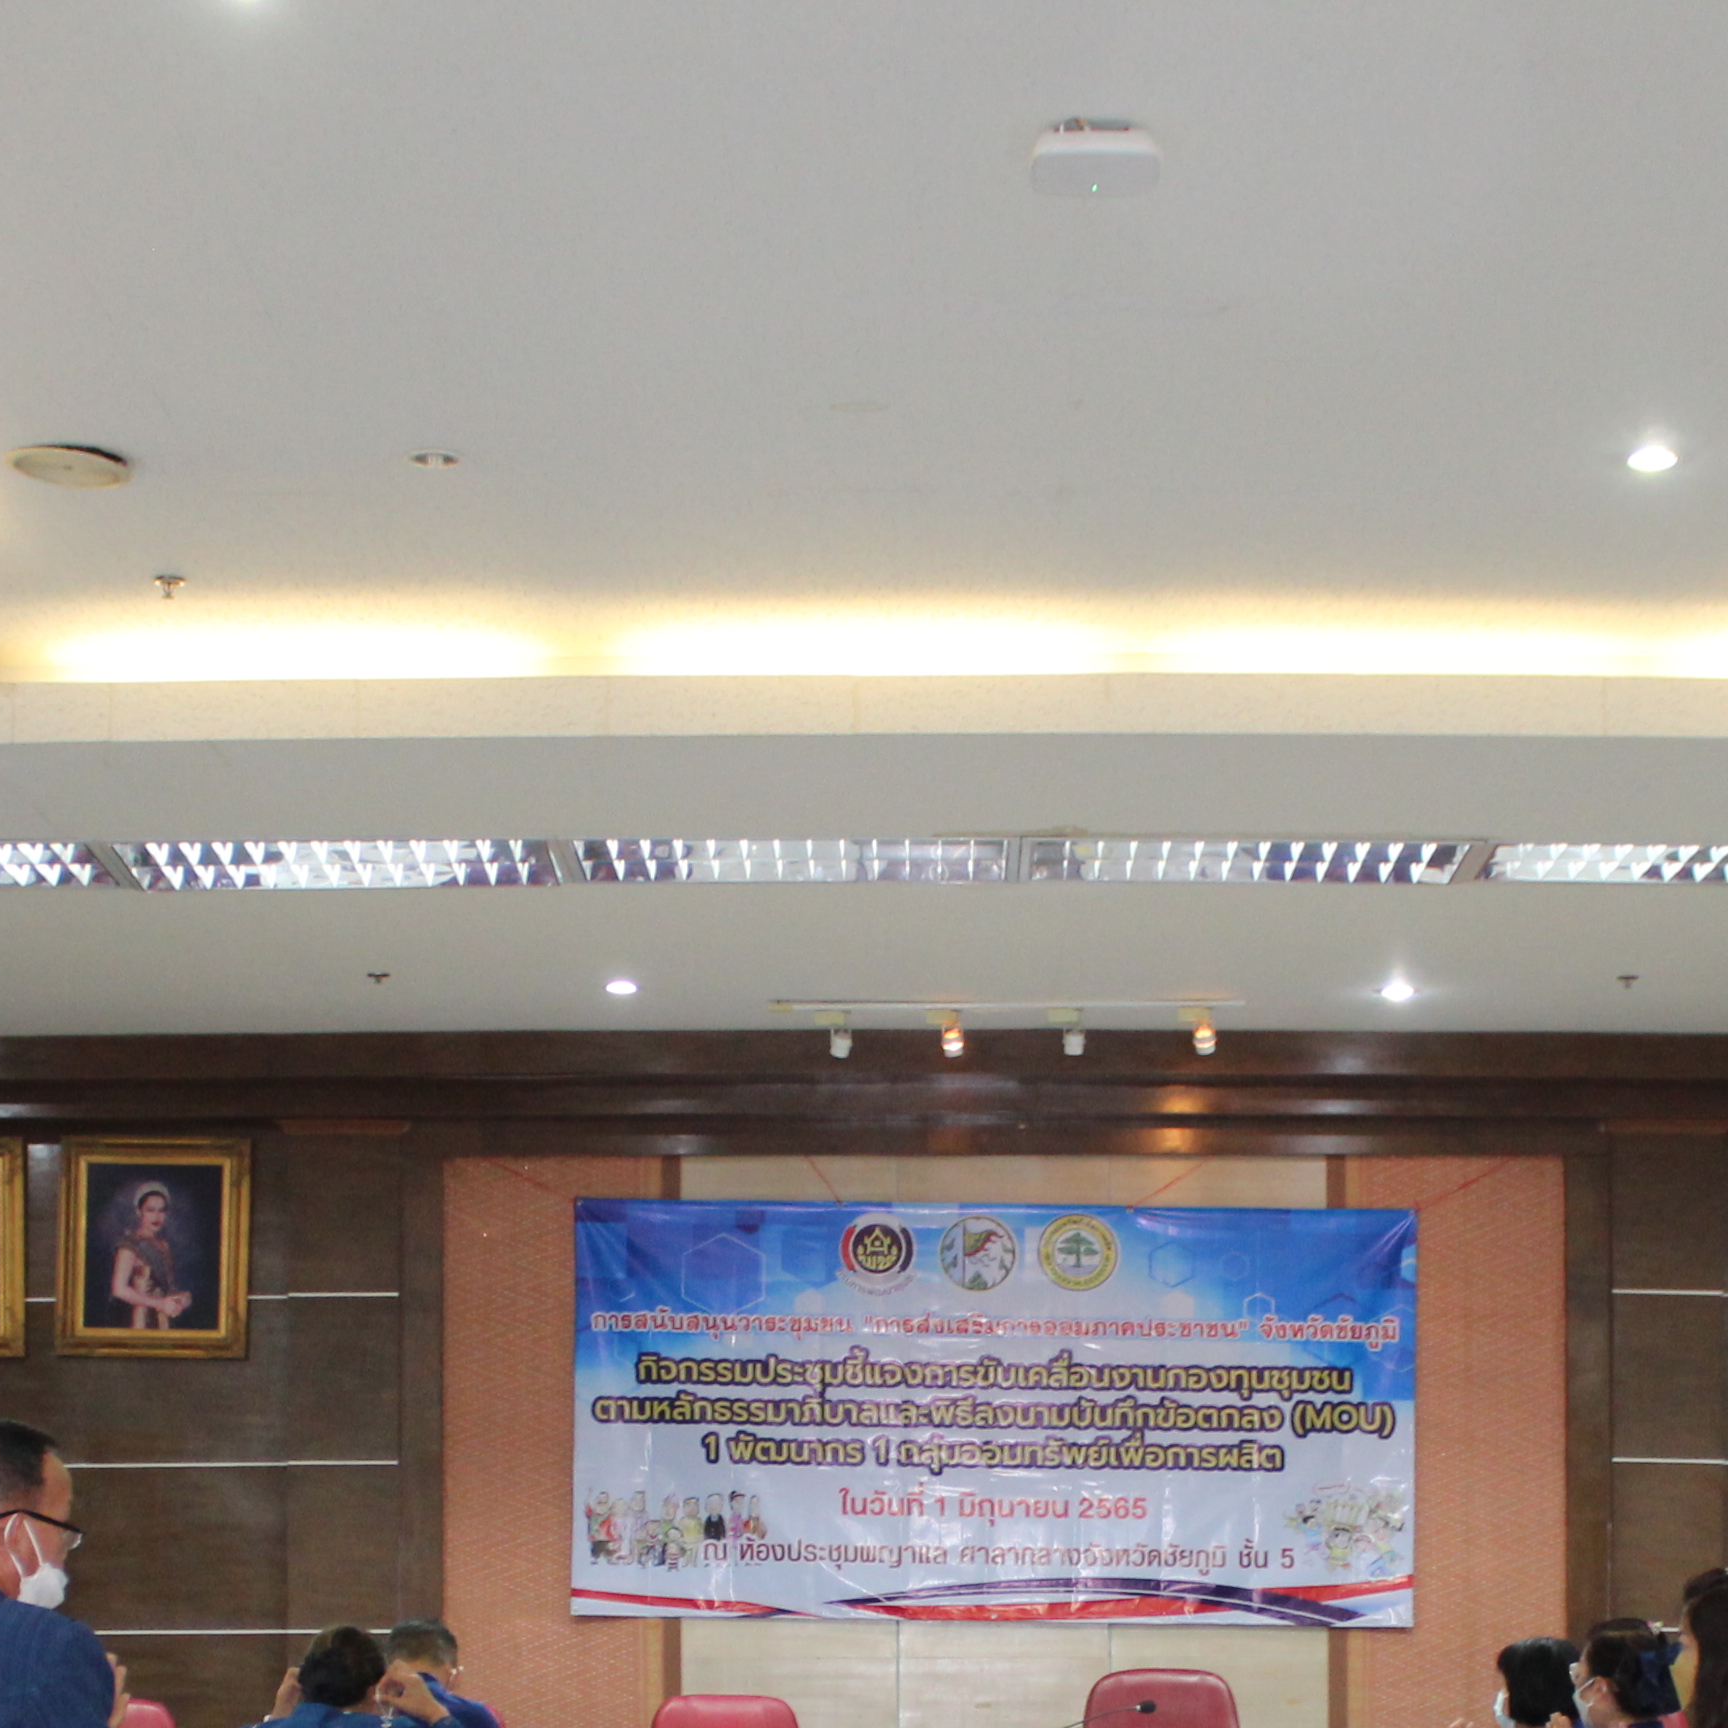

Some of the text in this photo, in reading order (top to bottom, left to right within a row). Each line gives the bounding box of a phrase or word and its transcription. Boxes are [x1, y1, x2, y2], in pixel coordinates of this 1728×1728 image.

[1258, 1316, 1399, 1349] จังหวัดชัยภูมิ
[637, 1346, 1352, 1398] กิจกรรมประชุมชี้แจงการขับเคลื่อนงานกองทุนชุมชน
[593, 1392, 1395, 1438] ตามหลักธรรมาภิบาลและพิธีลงนามบันทึกข้อตกลง (MOU)
[703, 1431, 1283, 1474] 1 พัฒนากร 1 กลุ่มออมทรัพย์เพื่อการผลิต
[839, 1483, 1148, 1527] ในวันที่ 1 มิถุนายน 2565
[704, 1541, 727, 1562] ณ
[958, 1542, 1227, 1576] ศาลากลางจังหวัดชัยภูมิ
[1238, 1538, 1270, 1568] ชั้น
[1280, 1548, 1295, 1568] 5
